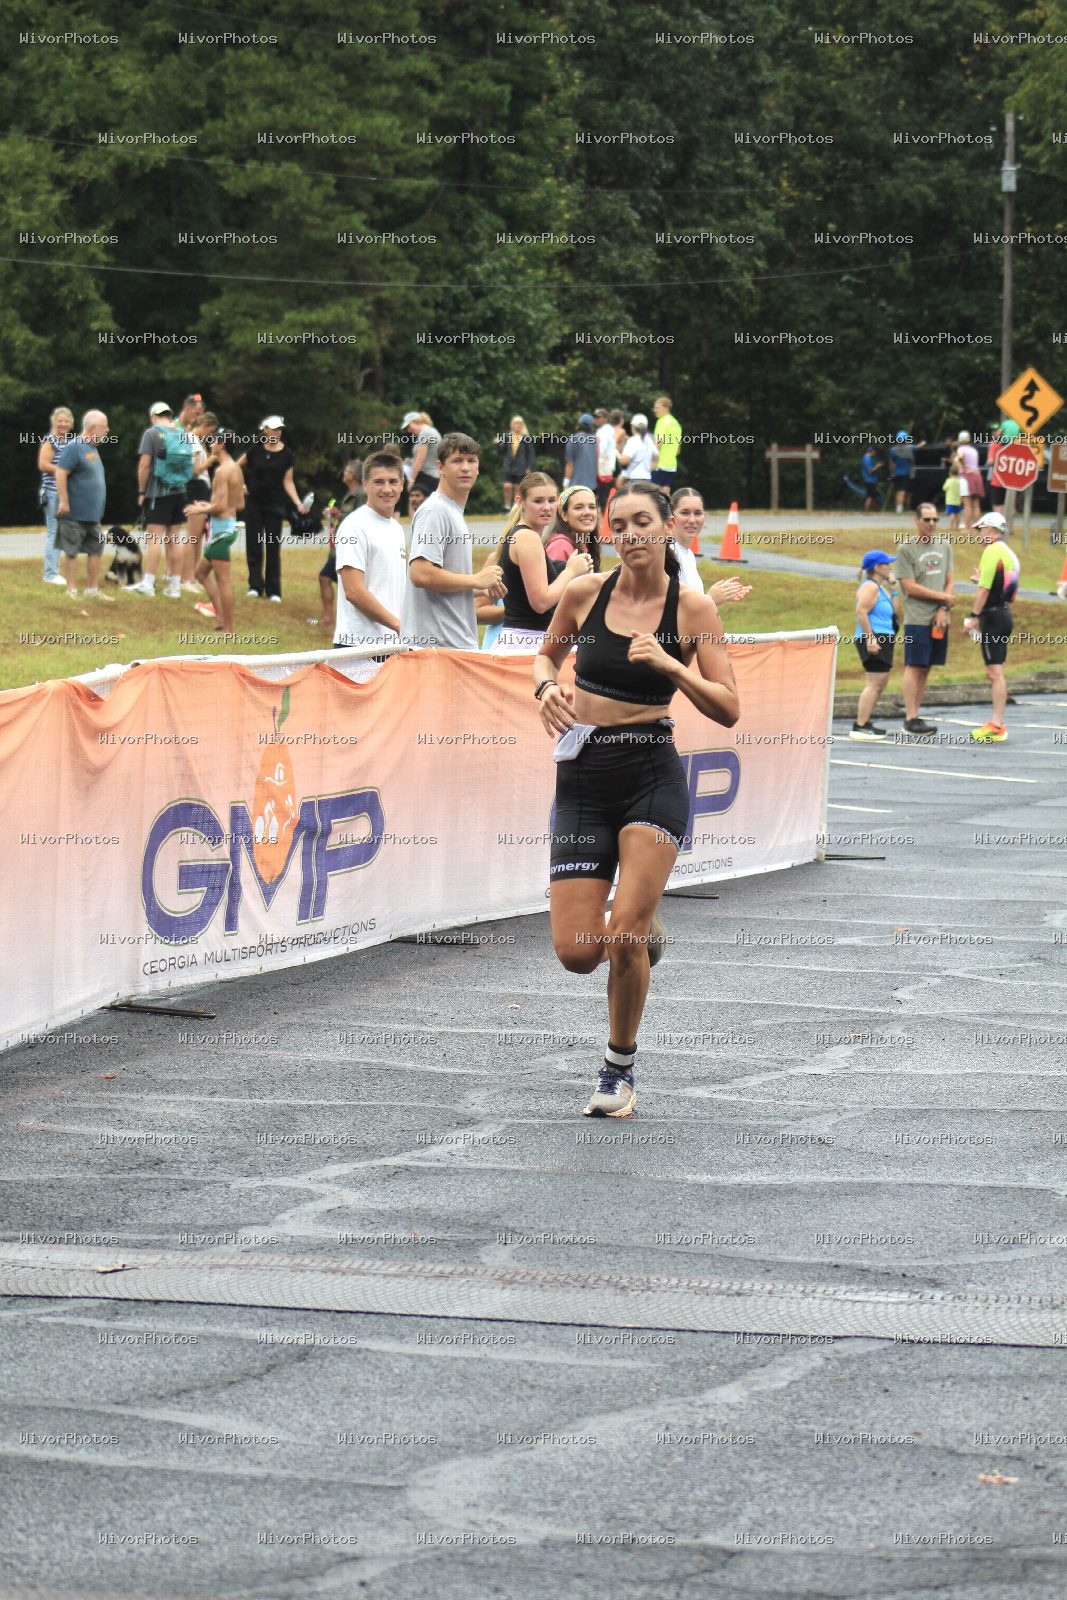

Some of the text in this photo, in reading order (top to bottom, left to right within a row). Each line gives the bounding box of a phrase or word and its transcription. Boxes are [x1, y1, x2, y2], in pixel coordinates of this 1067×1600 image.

[997, 456, 1036, 477] STOP
[141, 786, 386, 947] GMP
[204, 940, 287, 965] MULTISPORTS
